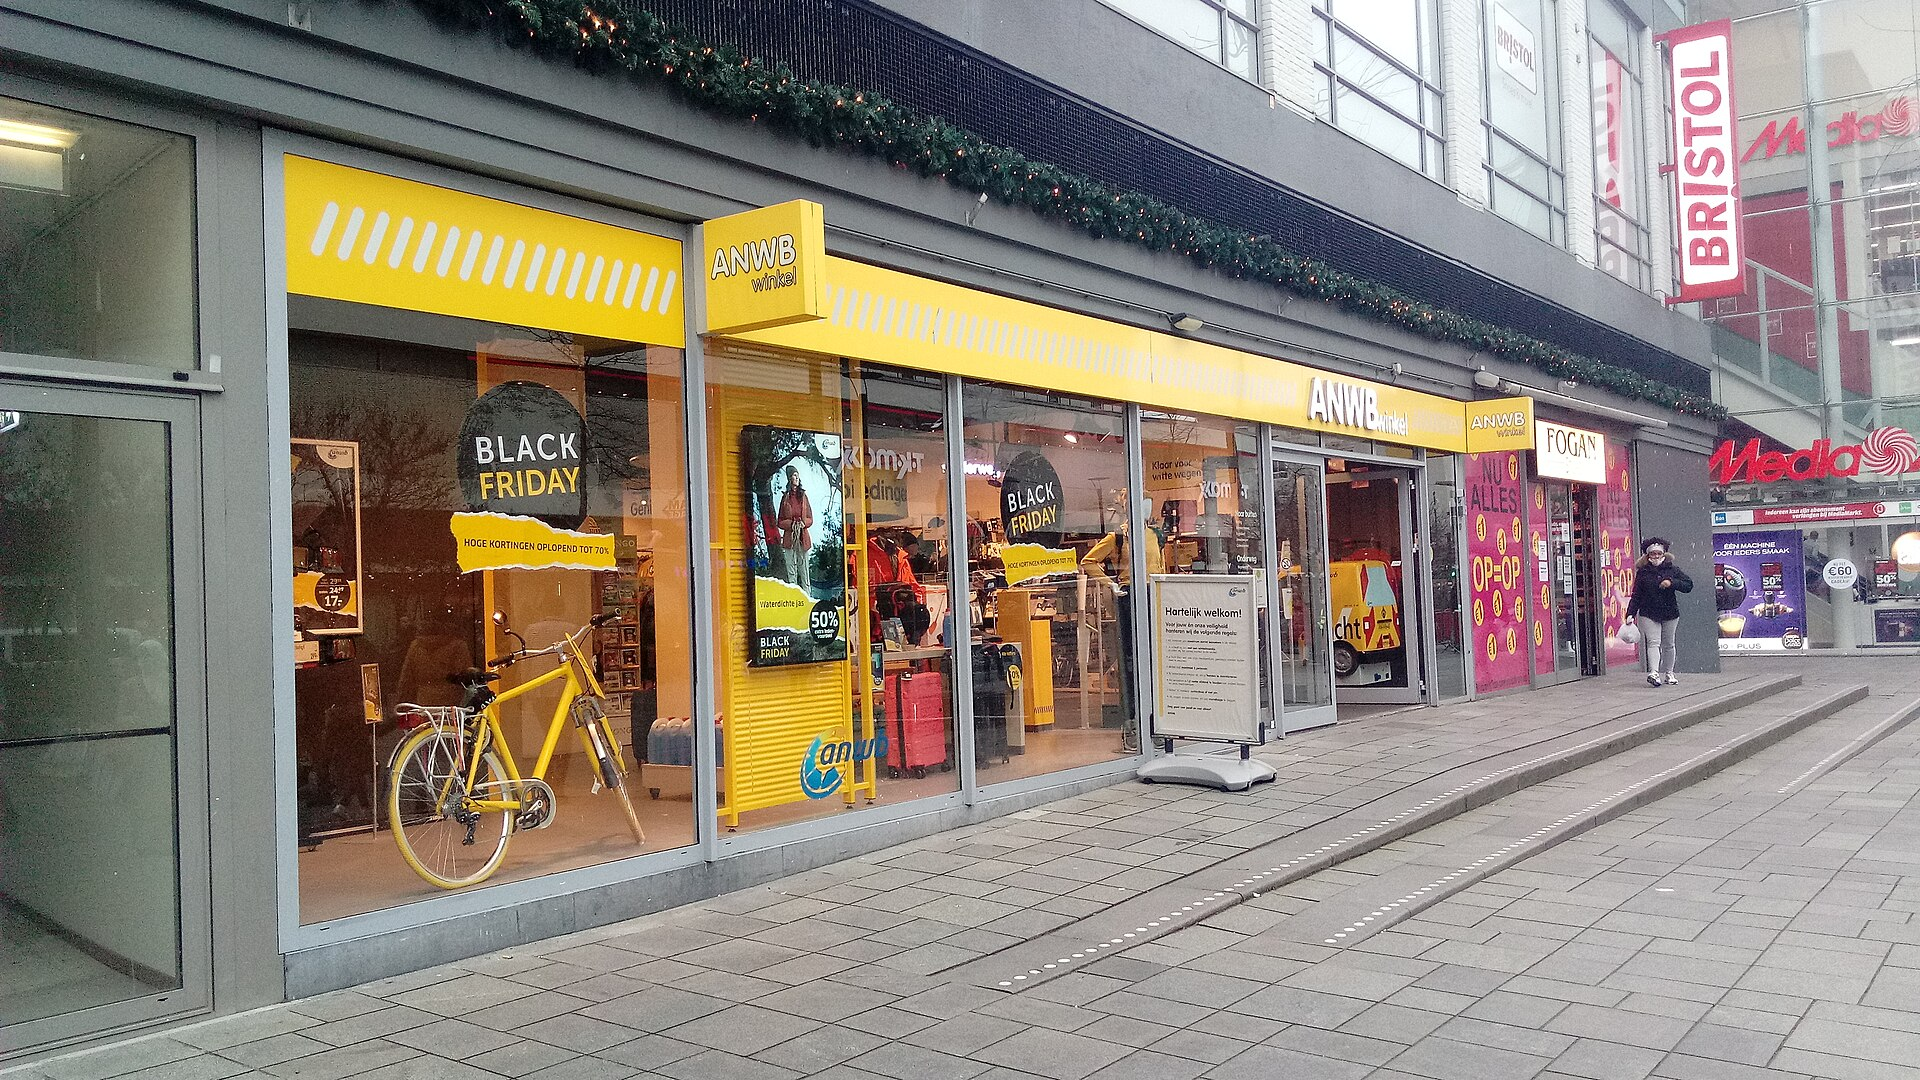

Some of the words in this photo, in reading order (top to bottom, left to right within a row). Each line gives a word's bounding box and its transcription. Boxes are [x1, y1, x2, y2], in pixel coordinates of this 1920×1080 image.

[1497, 25, 1535, 73] BRISTOL
[1680, 50, 1730, 266] BRISTOL
[711, 233, 797, 281] ANWB
[751, 266, 797, 293] winkel
[1308, 376, 1378, 431] ANWB
[1377, 411, 1409, 437] winkel
[1471, 411, 1525, 431] ANWB
[1497, 428, 1526, 438] winkel
[1547, 427, 1597, 460] FOGAN
[475, 432, 579, 464] BLACK
[1151, 460, 1172, 470] Klaar
[1482, 456, 1502, 486] NU
[1709, 438, 1864, 485] Media
[479, 466, 580, 500] FRIDAY
[1151, 471, 1173, 481] witte
[1007, 481, 1055, 513] BLACK
[1471, 483, 1518, 515] ALLES
[1011, 504, 1057, 537] FRIDAY
[464, 538, 487, 548] HOGE
[489, 540, 535, 551] KORTINGEN
[537, 542, 578, 553] OPLOPEND
[579, 545, 593, 554] TOT
[595, 546, 610, 555] 70%
[1734, 548, 1761, 556] IEDERS
[1762, 547, 1790, 555] SMAAK
[1740, 541, 1776, 549] MACHINE
[1019, 560, 1039, 568] KORTINGEN
[1473, 555, 1521, 593] OP=OP
[1828, 566, 1852, 576] €60
[1763, 577, 1782, 586] 50%
[1876, 574, 1897, 584] 50%
[760, 600, 795, 608] Waterdichte
[796, 599, 805, 608] jas
[1165, 607, 1202, 619] Hartelijk
[1203, 607, 1242, 618] welkom!
[811, 610, 839, 628] 50%
[760, 635, 790, 648] BLACK
[760, 647, 790, 659] FRIDAY
[820, 727, 889, 766] anwb
